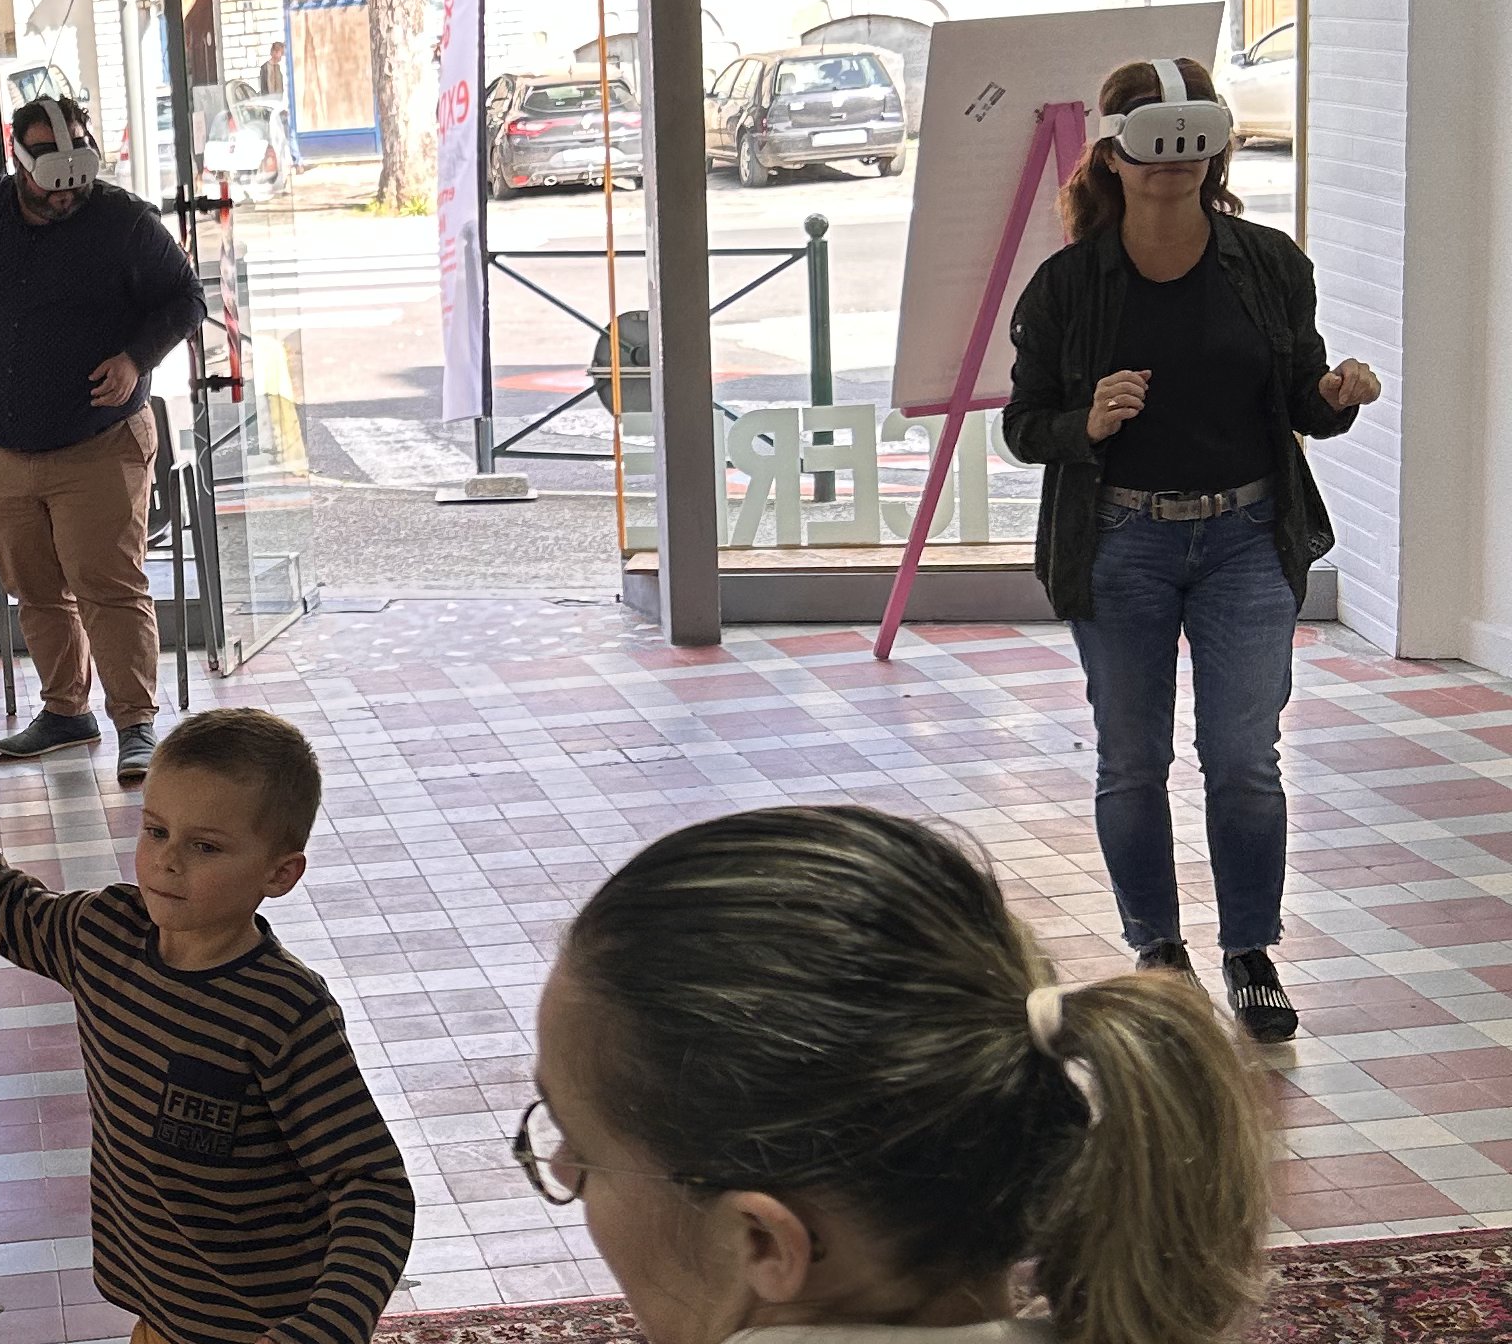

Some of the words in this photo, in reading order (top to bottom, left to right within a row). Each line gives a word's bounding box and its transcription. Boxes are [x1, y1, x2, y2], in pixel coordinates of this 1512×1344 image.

[1176, 118, 1185, 131] 3
[168, 1089, 234, 1130] FREE
[157, 1116, 232, 1157] GAME
